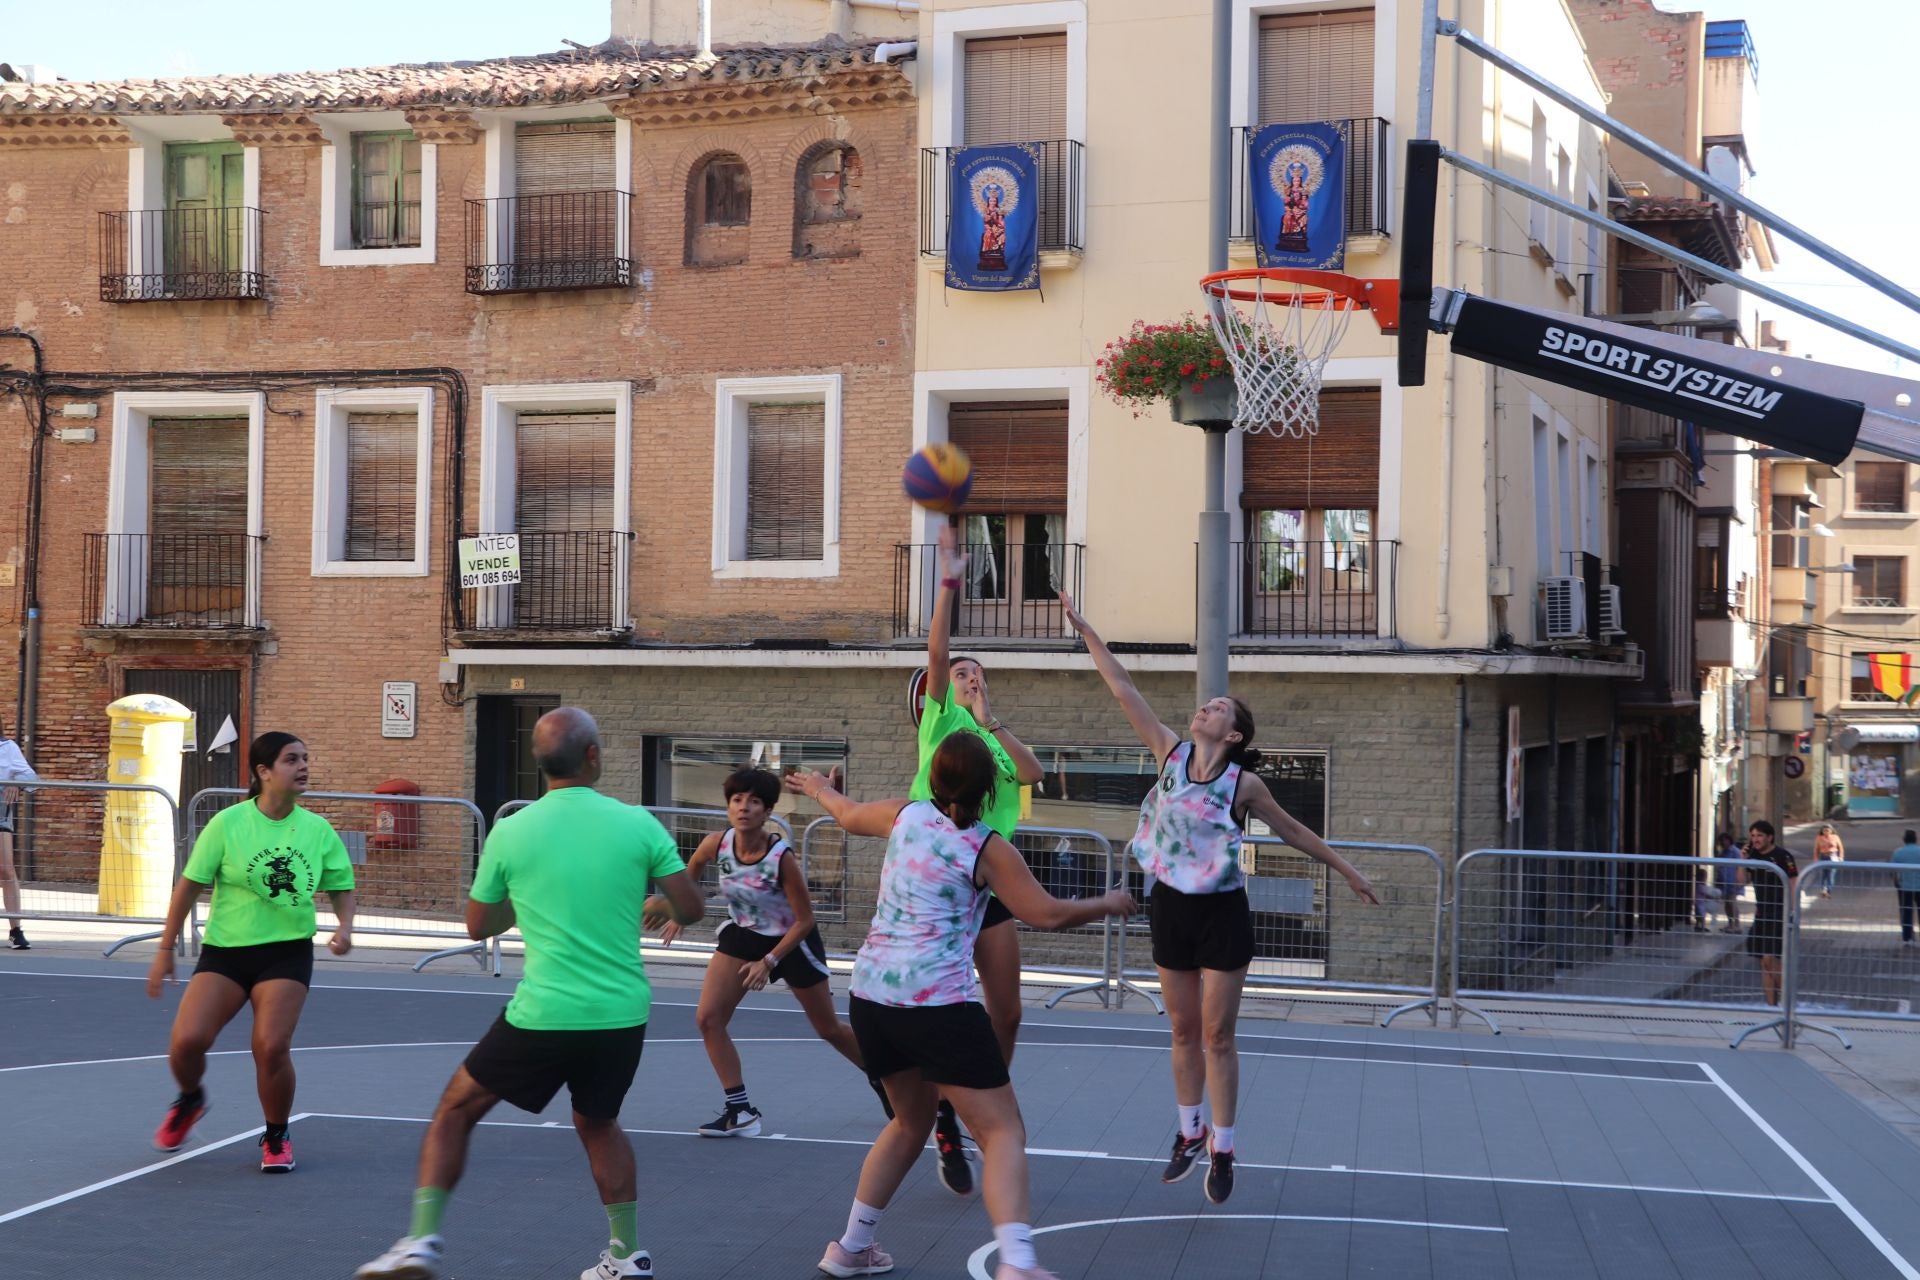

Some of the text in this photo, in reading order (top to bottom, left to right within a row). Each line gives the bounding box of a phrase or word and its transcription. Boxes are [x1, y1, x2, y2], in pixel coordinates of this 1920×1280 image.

[1543, 327, 1783, 412] SPORT SYSTEM
[475, 536, 516, 553] INTEC
[468, 556, 510, 571] VENDE
[462, 569, 519, 586] 601 085 694
[246, 848, 272, 873] SUPER
